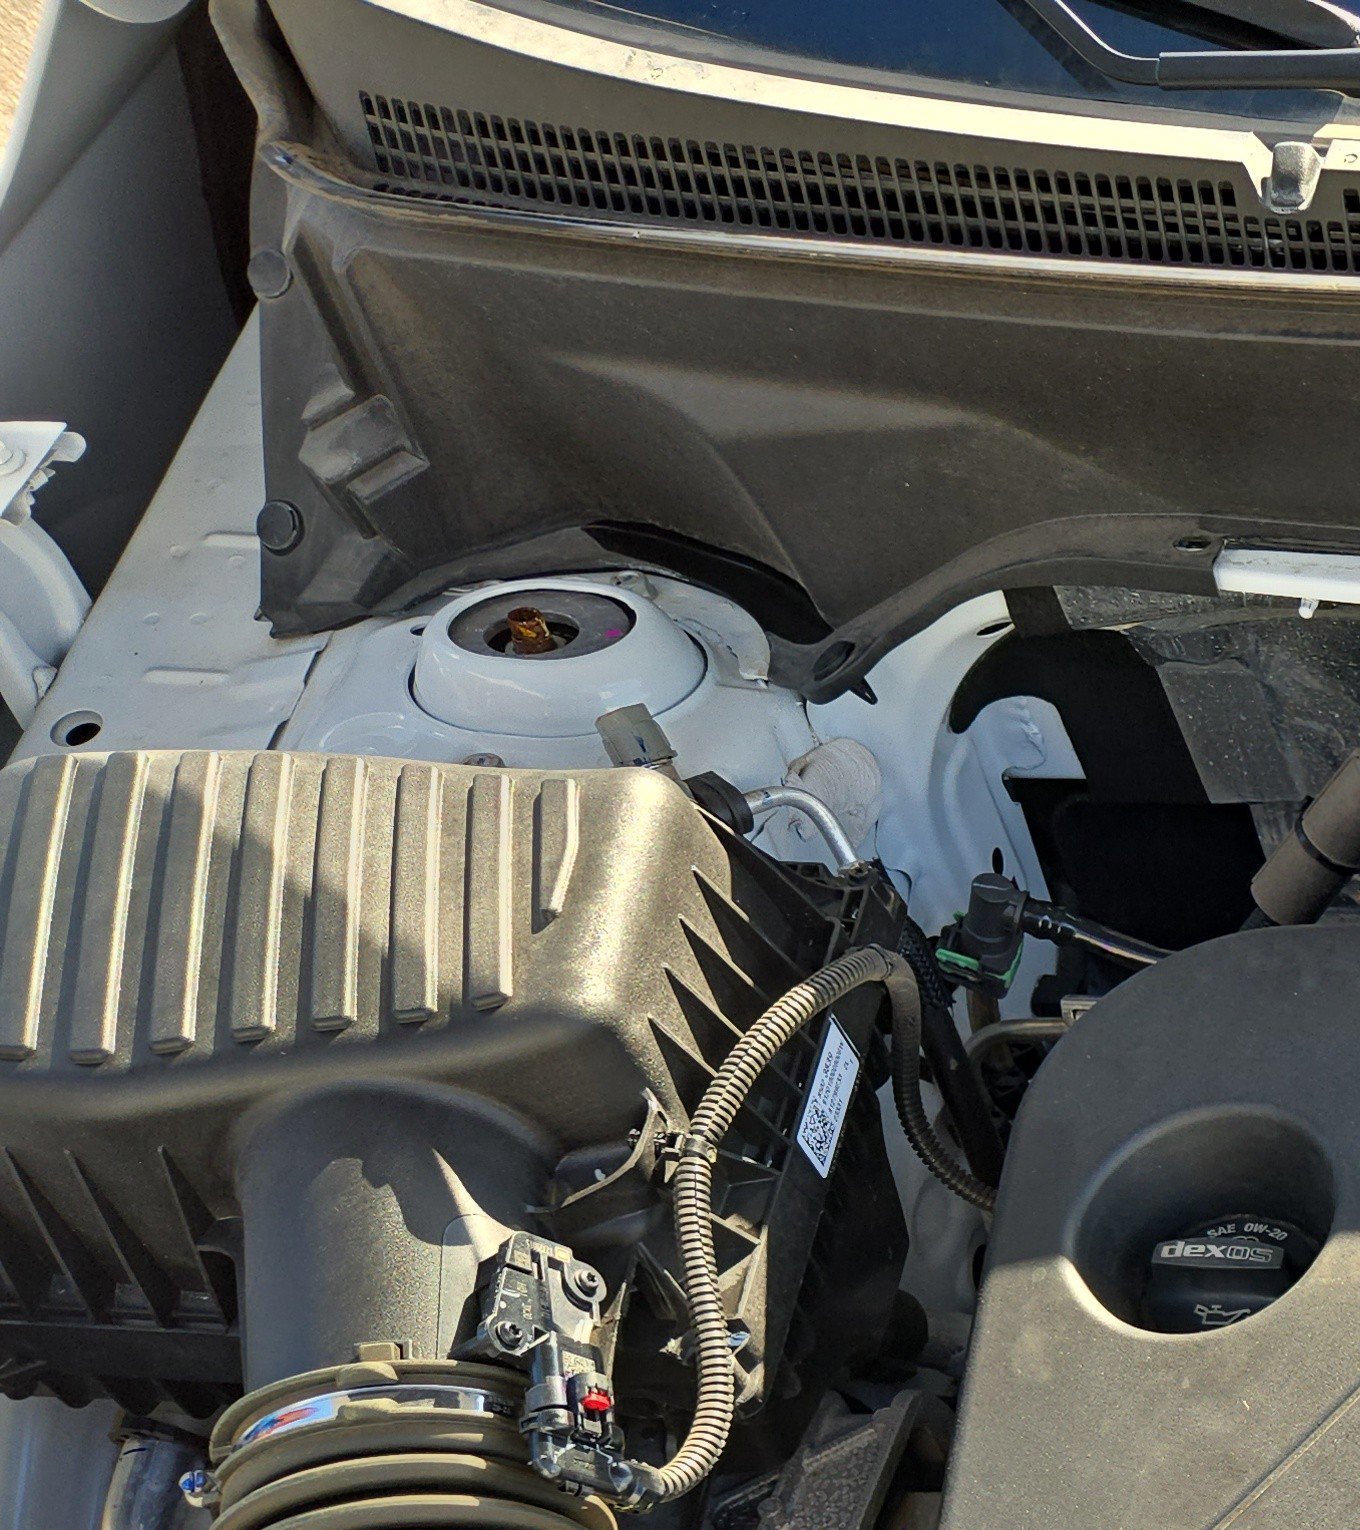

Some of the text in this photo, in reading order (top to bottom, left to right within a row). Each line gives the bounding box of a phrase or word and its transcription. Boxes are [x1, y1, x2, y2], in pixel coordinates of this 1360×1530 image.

[1206, 1222, 1288, 1241] SAE 0W-20
[1160, 1241, 1274, 1263] dexos
